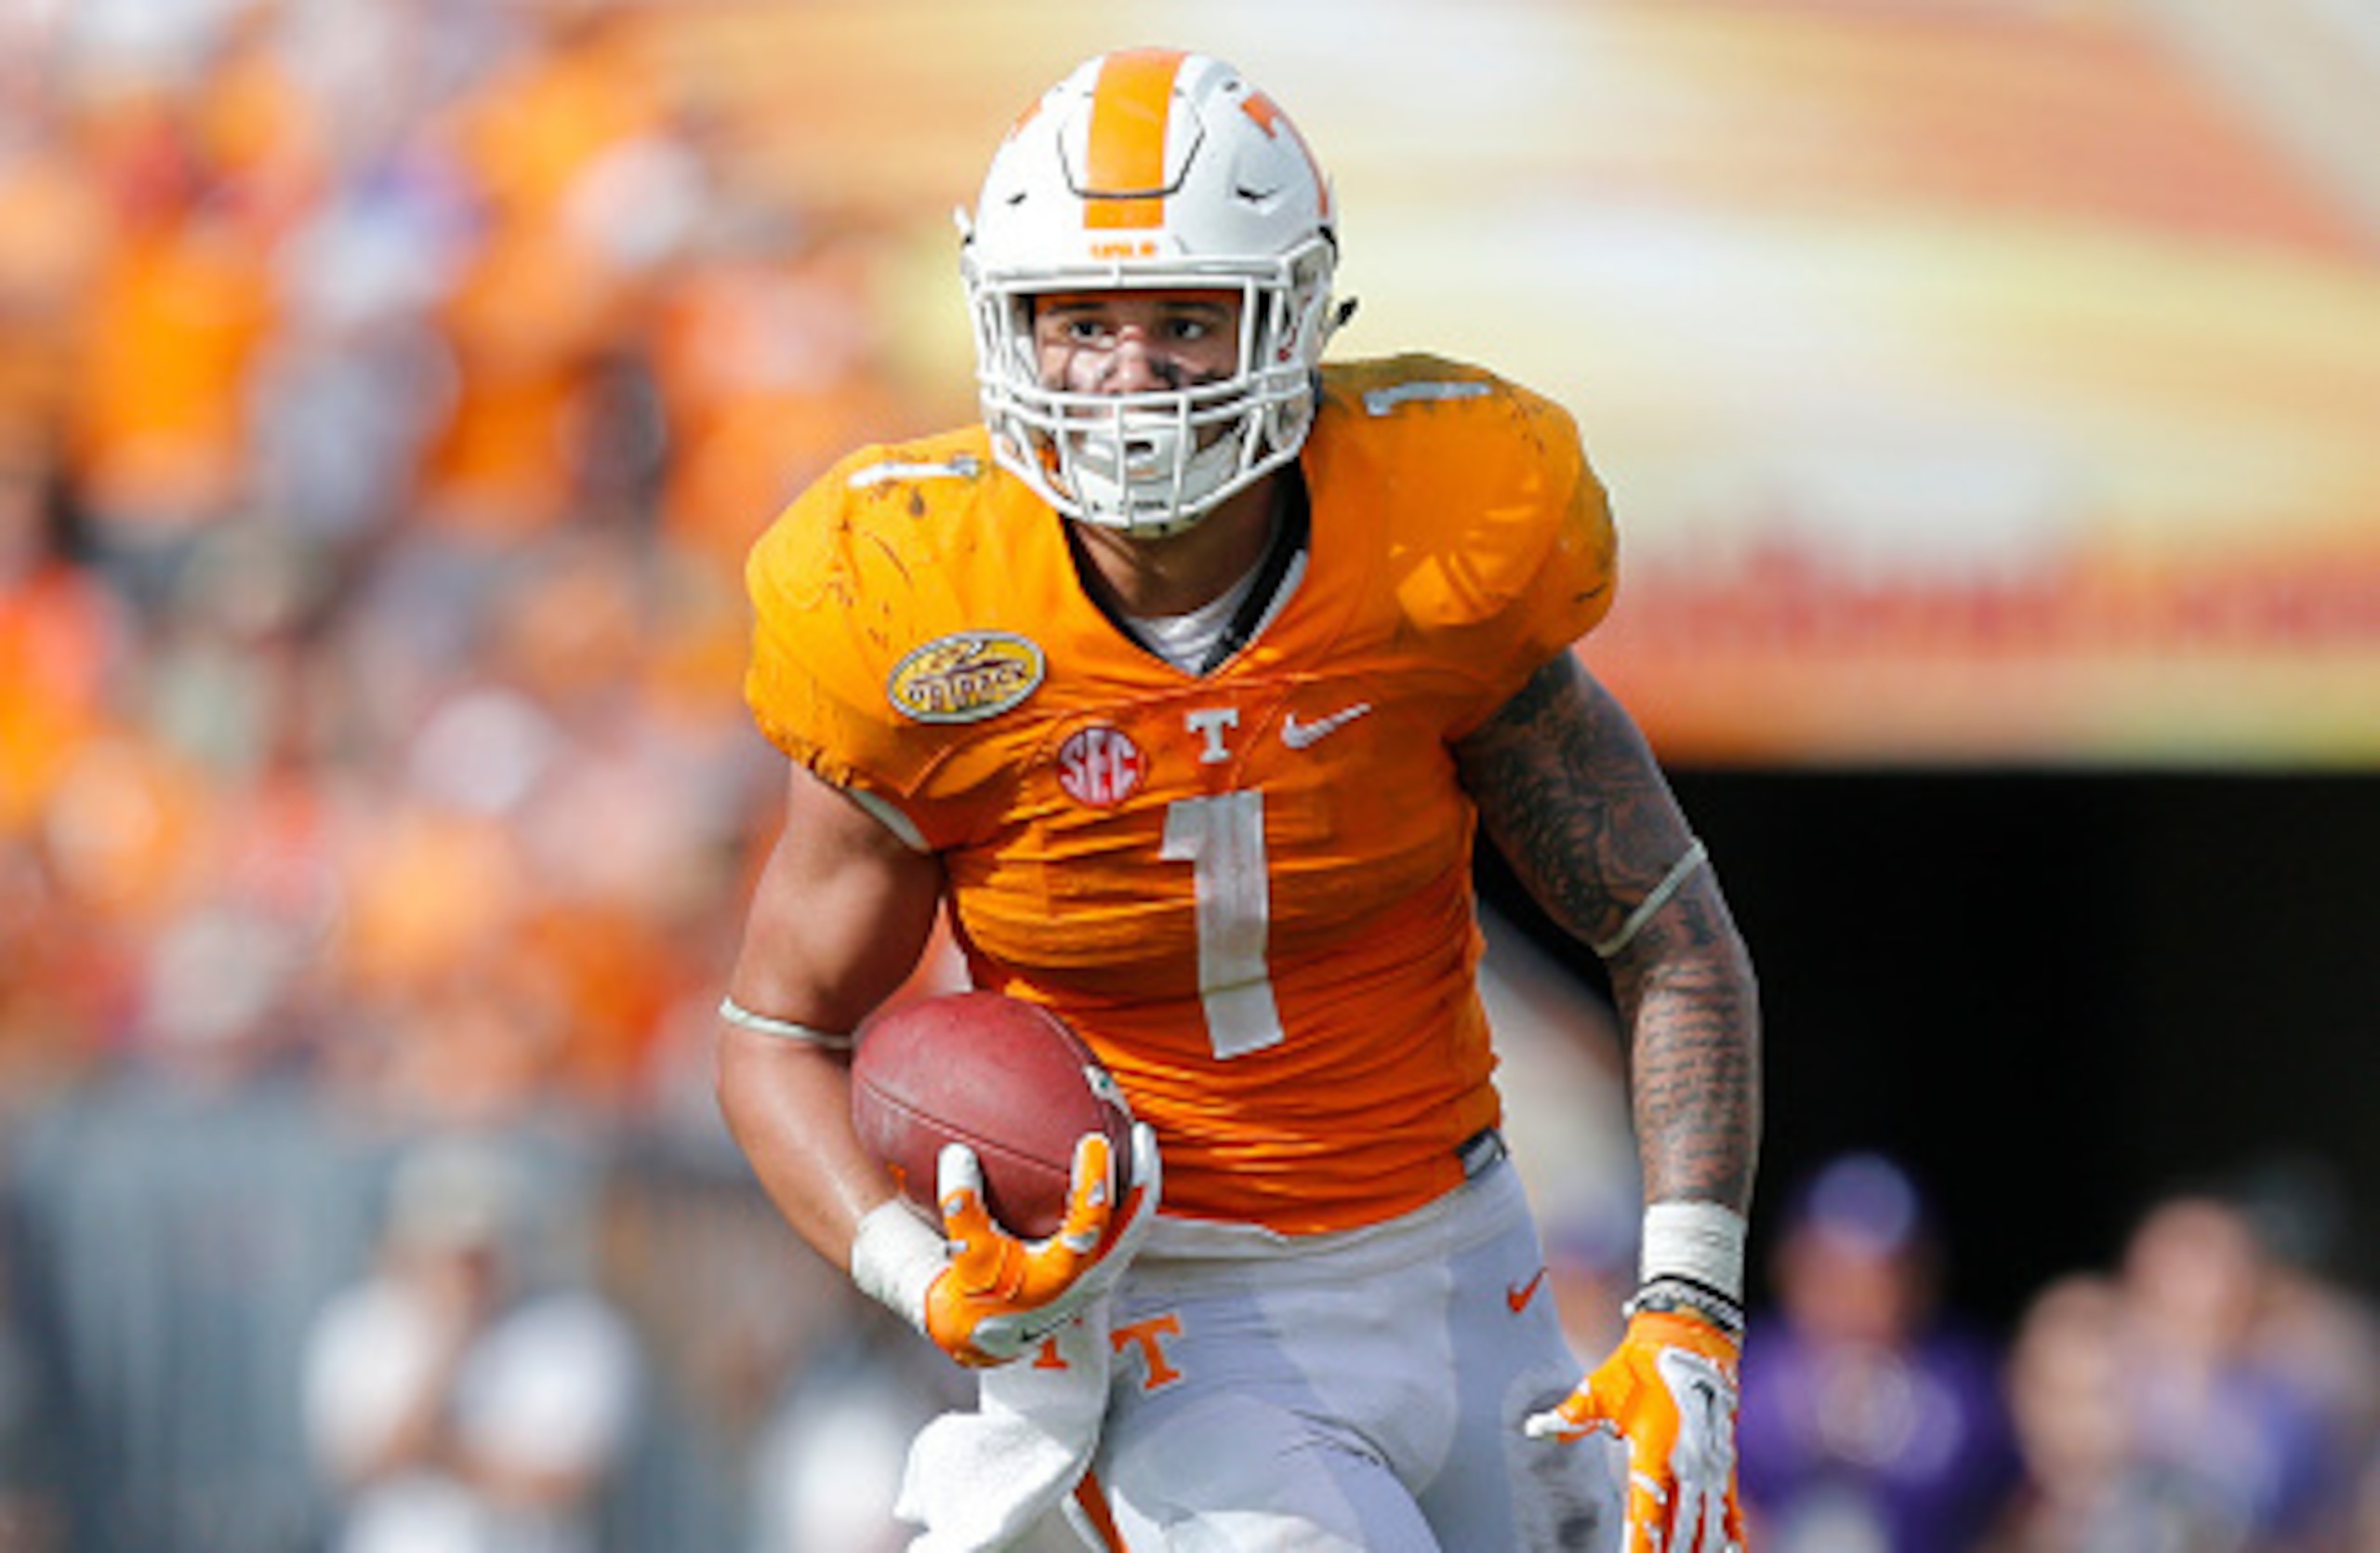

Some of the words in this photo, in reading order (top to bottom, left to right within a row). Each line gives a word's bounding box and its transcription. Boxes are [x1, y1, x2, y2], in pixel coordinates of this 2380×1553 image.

[1061, 728, 1136, 803] SEC
[1185, 709, 1237, 763] T
[1160, 790, 1284, 1059] 1
[1110, 1312, 1182, 1389] T
